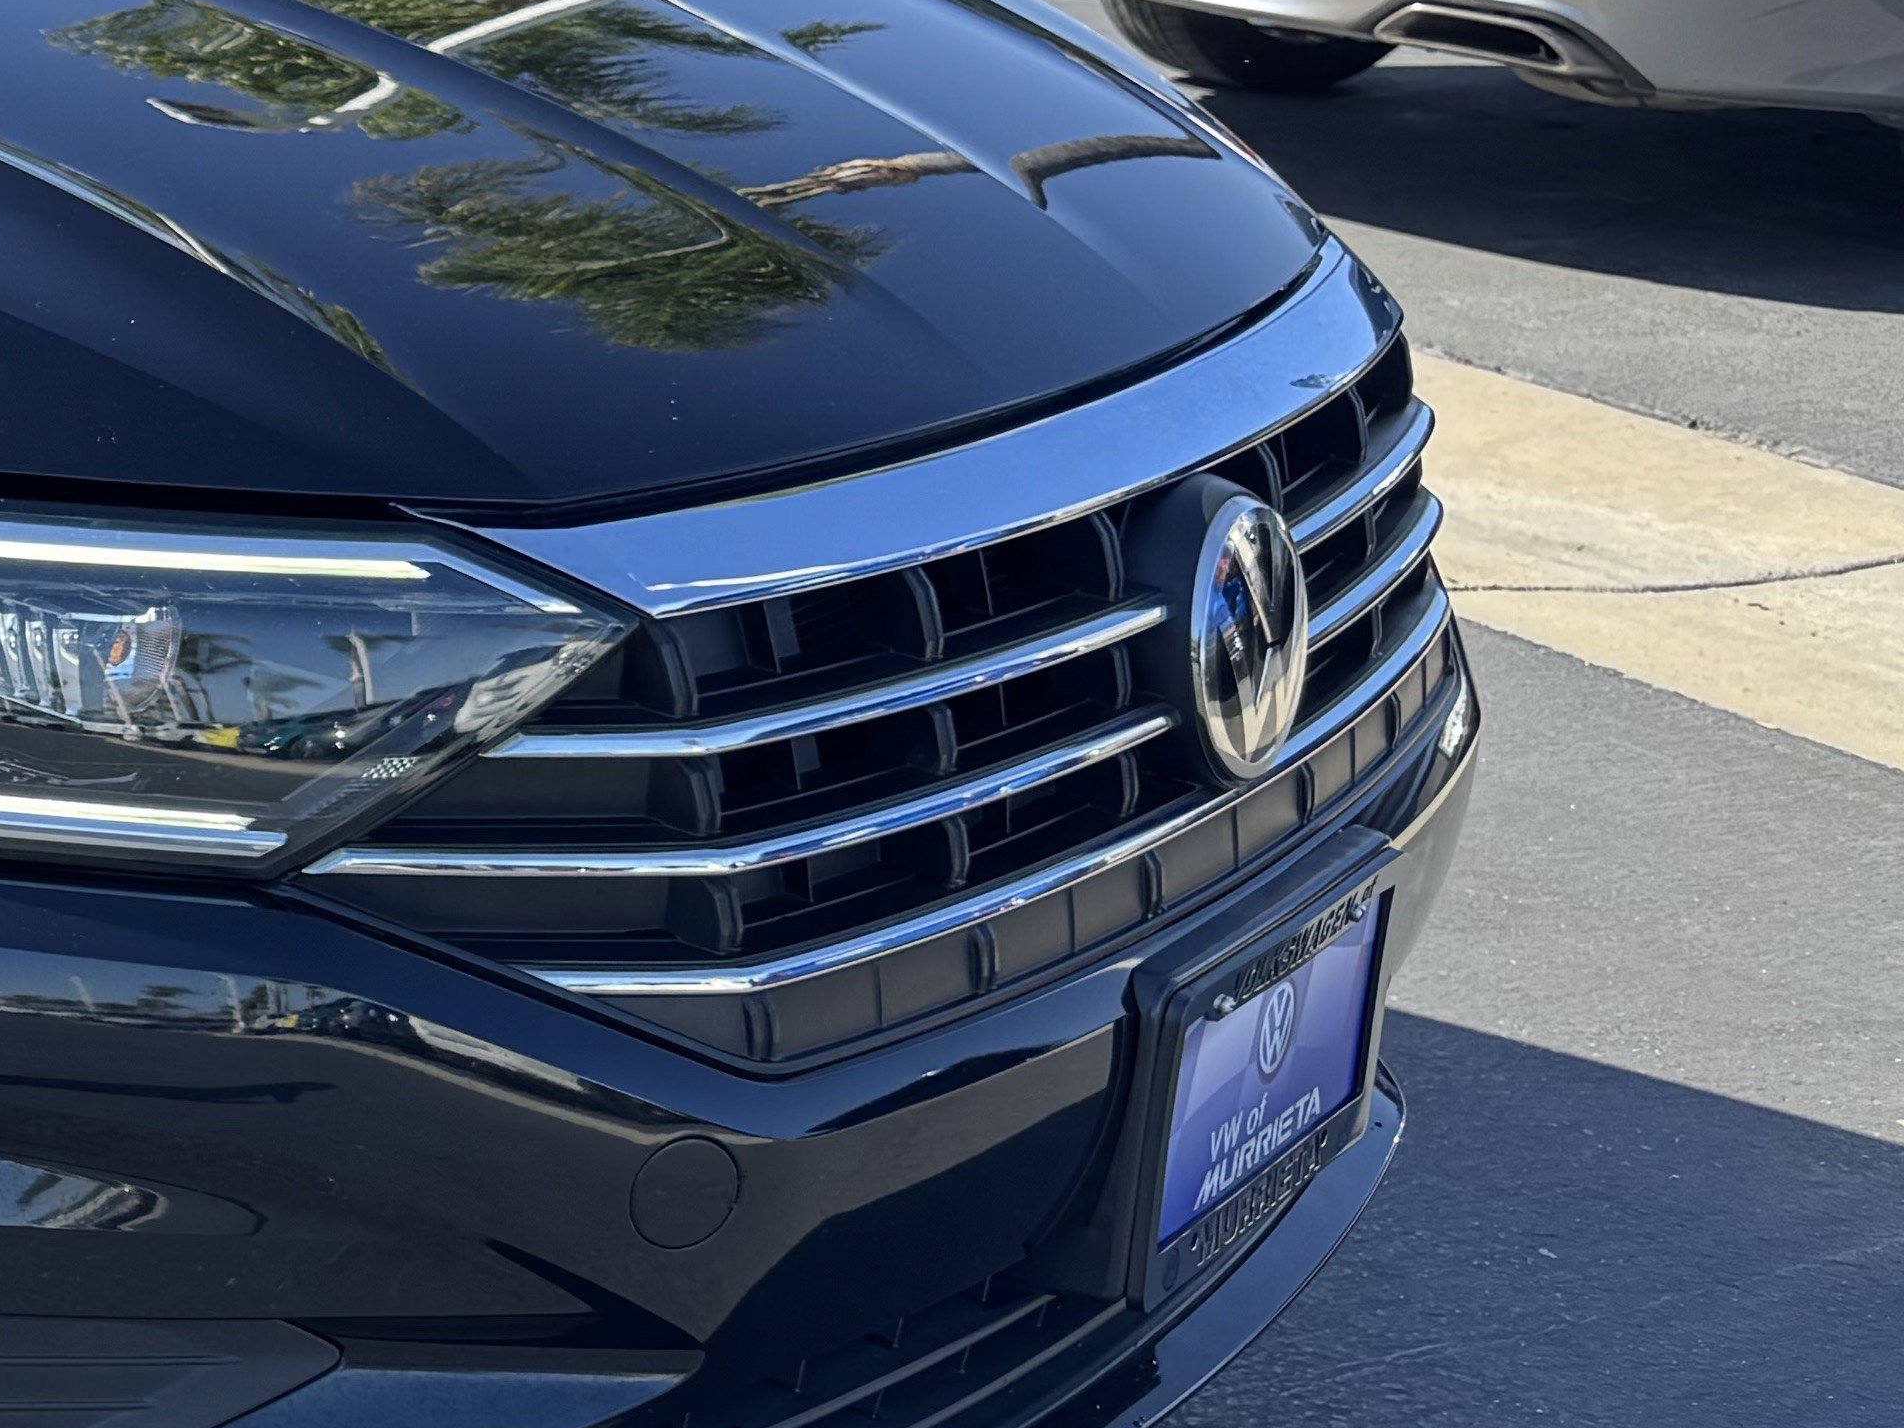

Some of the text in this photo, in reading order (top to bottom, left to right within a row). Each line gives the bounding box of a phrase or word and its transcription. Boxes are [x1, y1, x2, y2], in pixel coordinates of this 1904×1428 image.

[1233, 890, 1359, 1003] VOLKSWAGEN
[1193, 1086, 1322, 1212] MURRIETA
[1210, 1091, 1269, 1164] VW of
